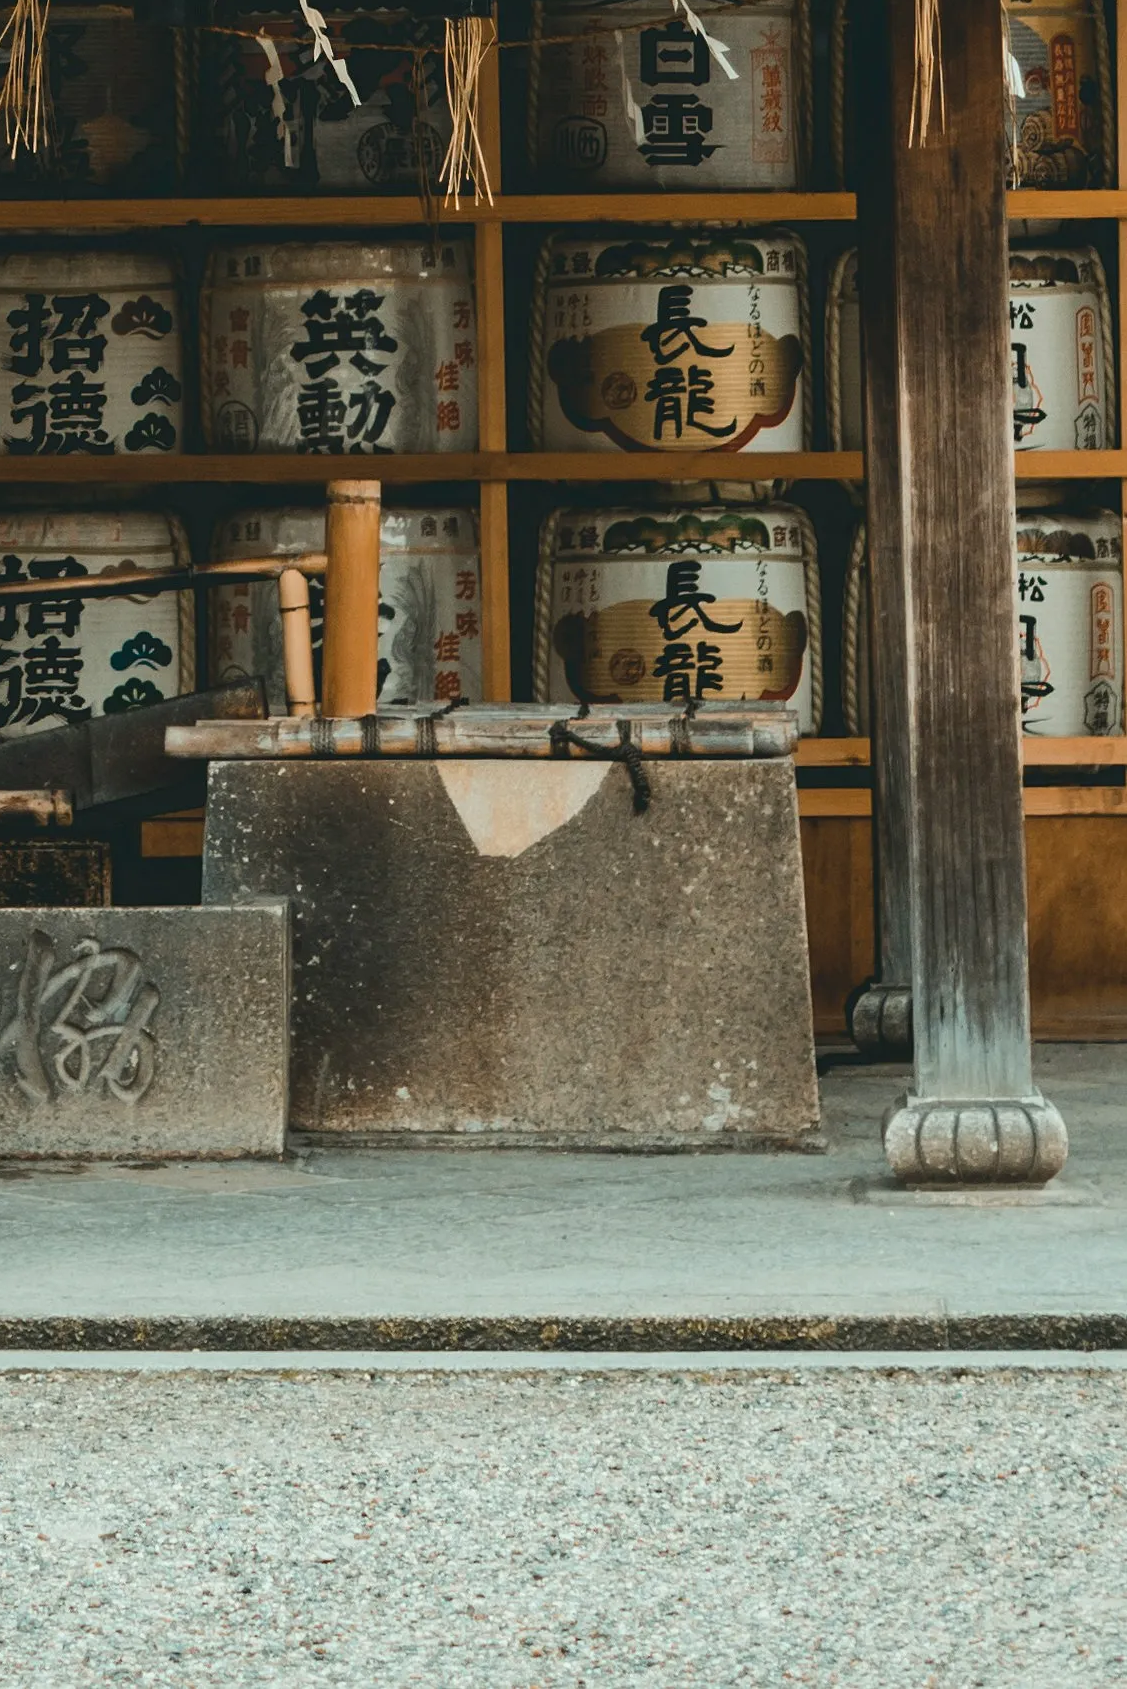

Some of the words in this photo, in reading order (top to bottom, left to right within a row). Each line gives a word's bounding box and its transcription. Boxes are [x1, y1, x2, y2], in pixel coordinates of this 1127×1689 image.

[637, 20, 726, 166] 白雪
[641, 285, 737, 439] 長龍
[746, 283, 767, 398] なるほどの酒
[650, 560, 743, 701] 長龍
[755, 559, 774, 674] なるほどの酒
